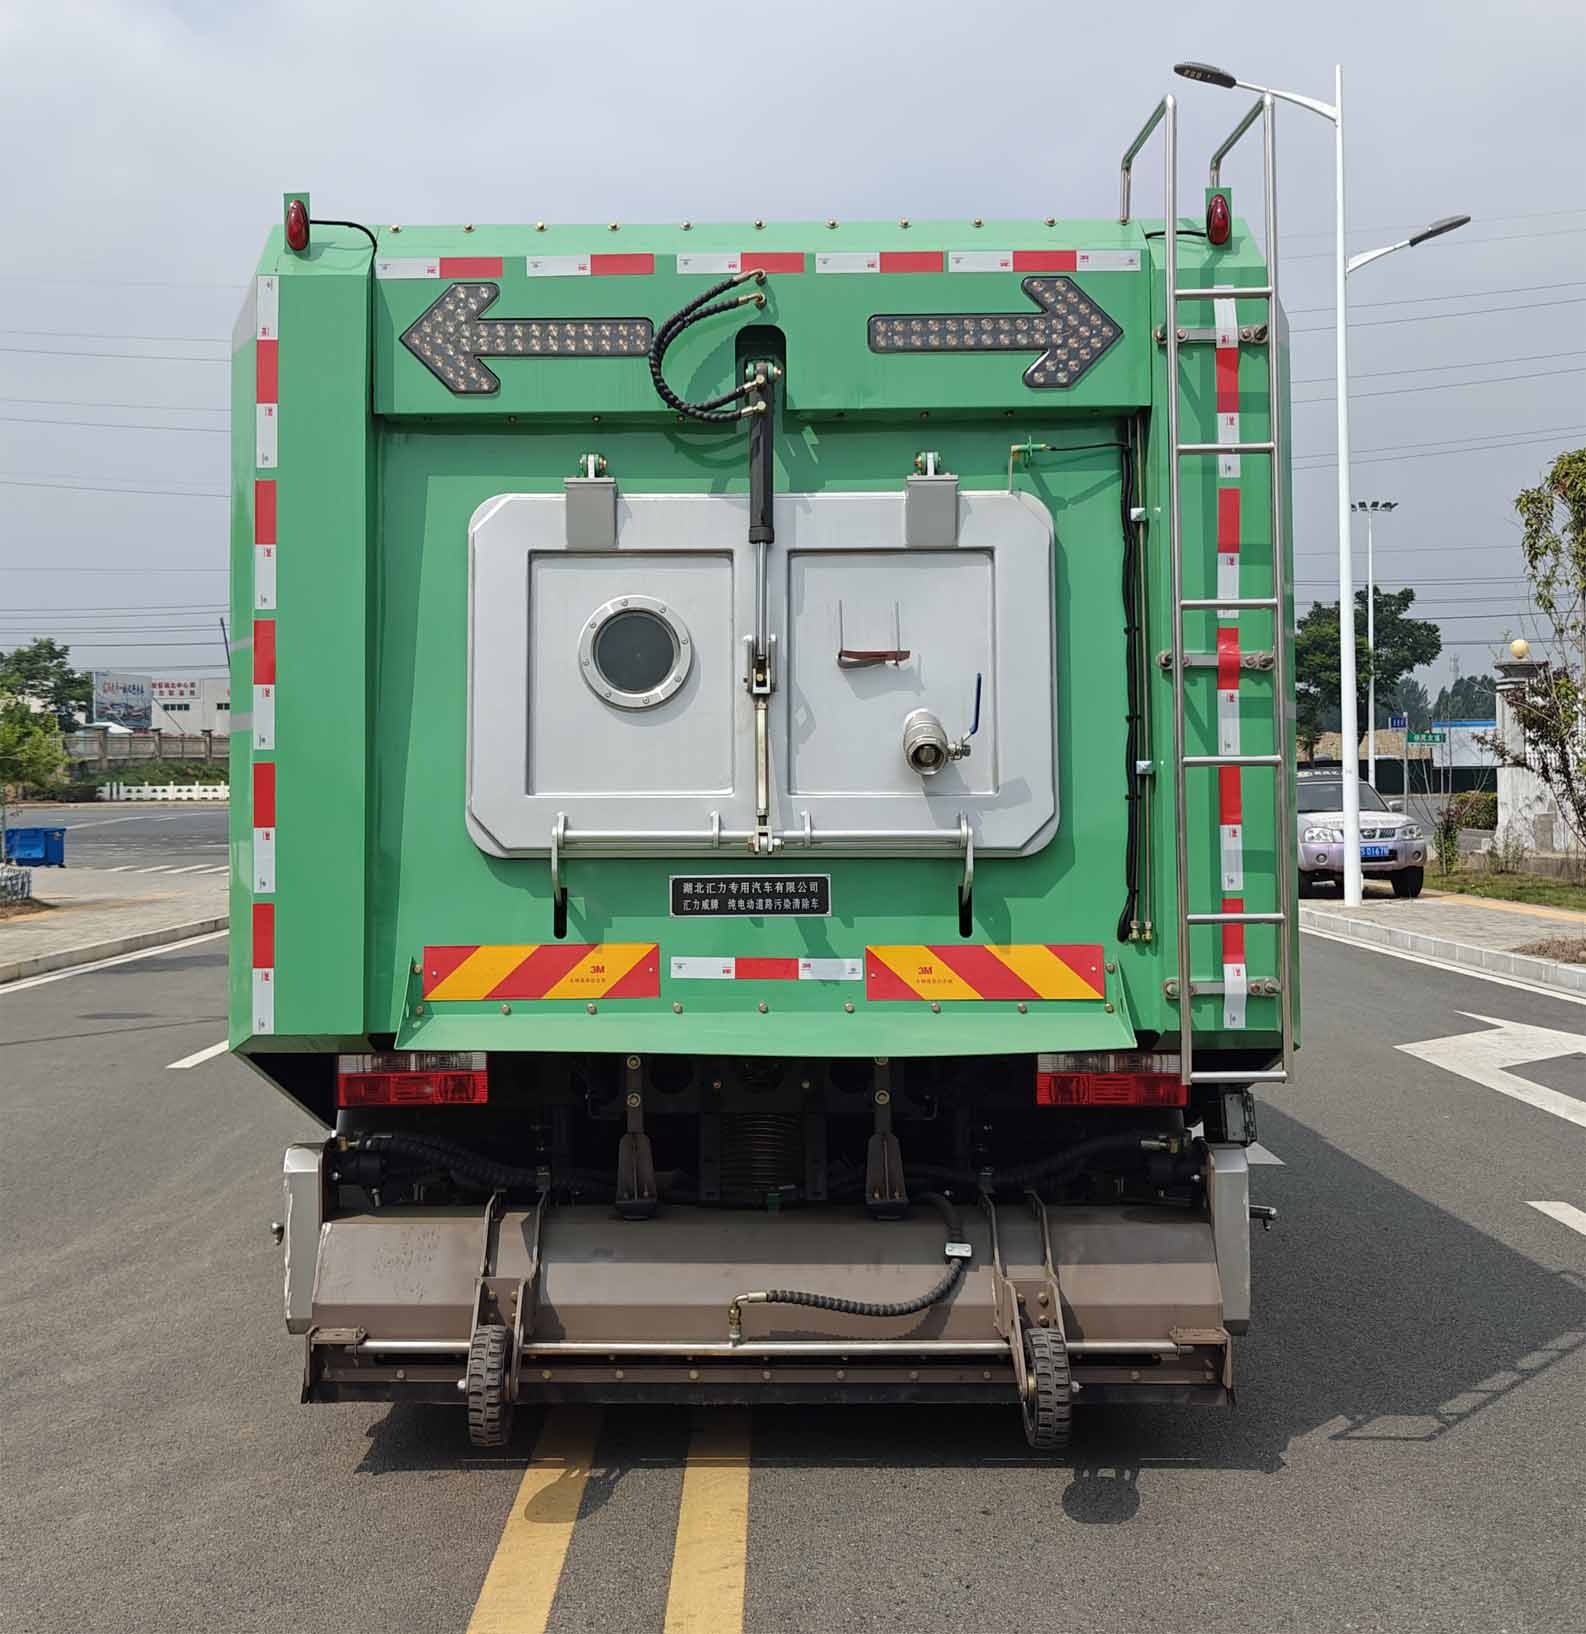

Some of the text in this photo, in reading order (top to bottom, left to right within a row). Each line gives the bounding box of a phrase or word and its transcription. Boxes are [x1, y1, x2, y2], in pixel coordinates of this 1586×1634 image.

[682, 881, 819, 894] 湖北汇力专用汽车有限公司
[590, 965, 605, 974] 3M
[918, 966, 932, 975] 3M
